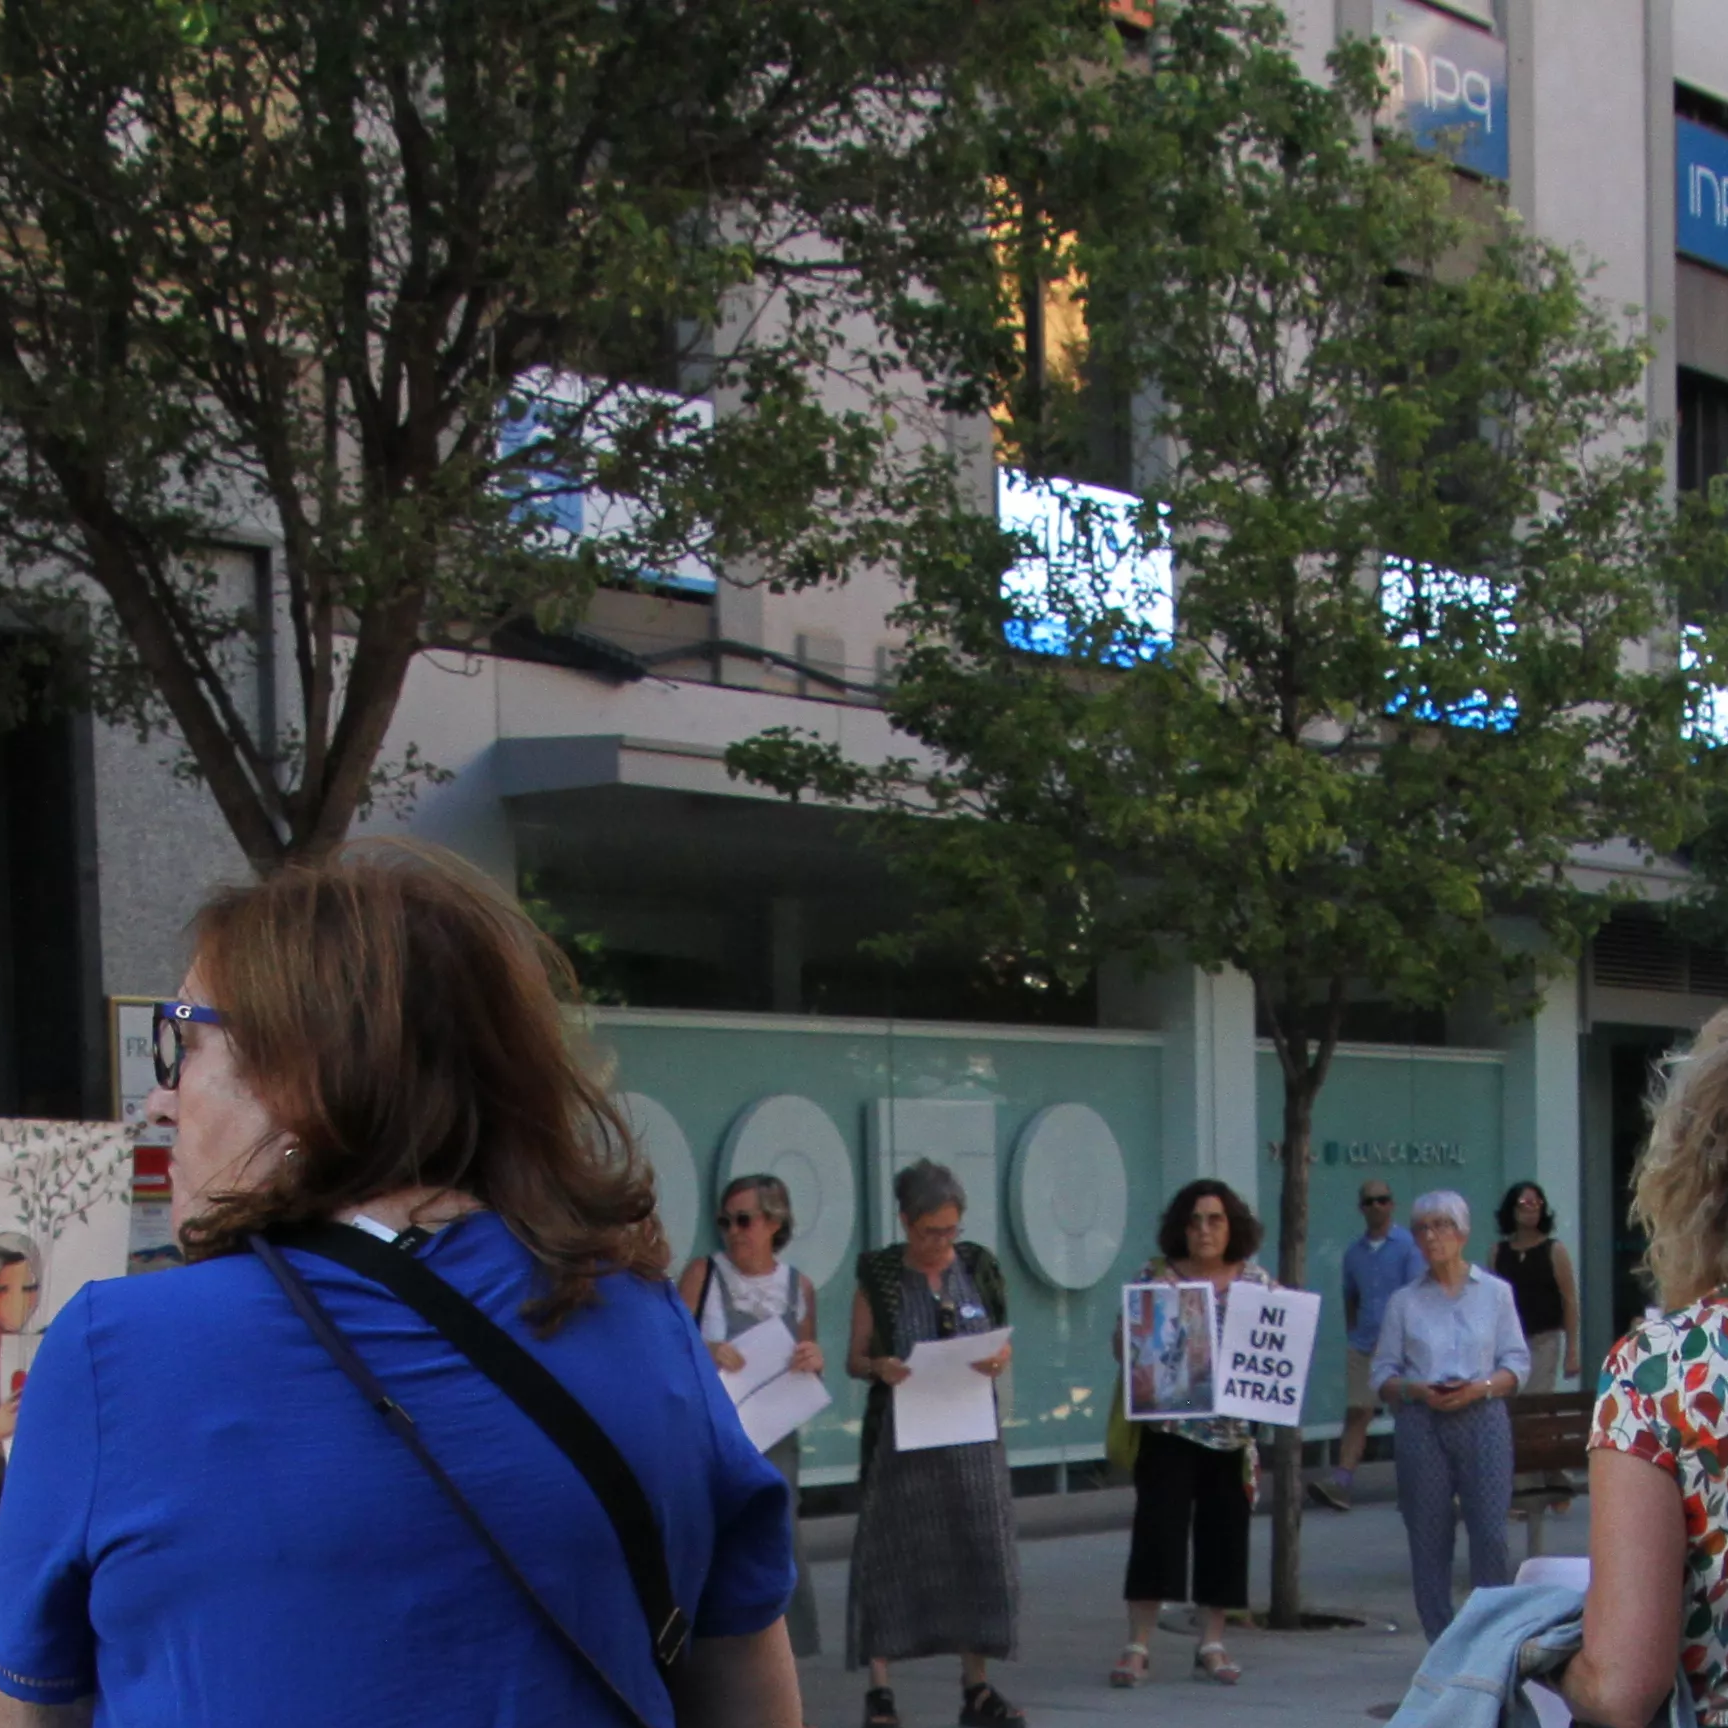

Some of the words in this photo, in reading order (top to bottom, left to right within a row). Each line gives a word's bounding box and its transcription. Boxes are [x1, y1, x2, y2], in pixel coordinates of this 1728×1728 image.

[1259, 1305, 1286, 1328] NI
[1249, 1329, 1286, 1352] UN
[1232, 1352, 1294, 1379] PASO
[1224, 1378, 1297, 1406] ATRÁS
